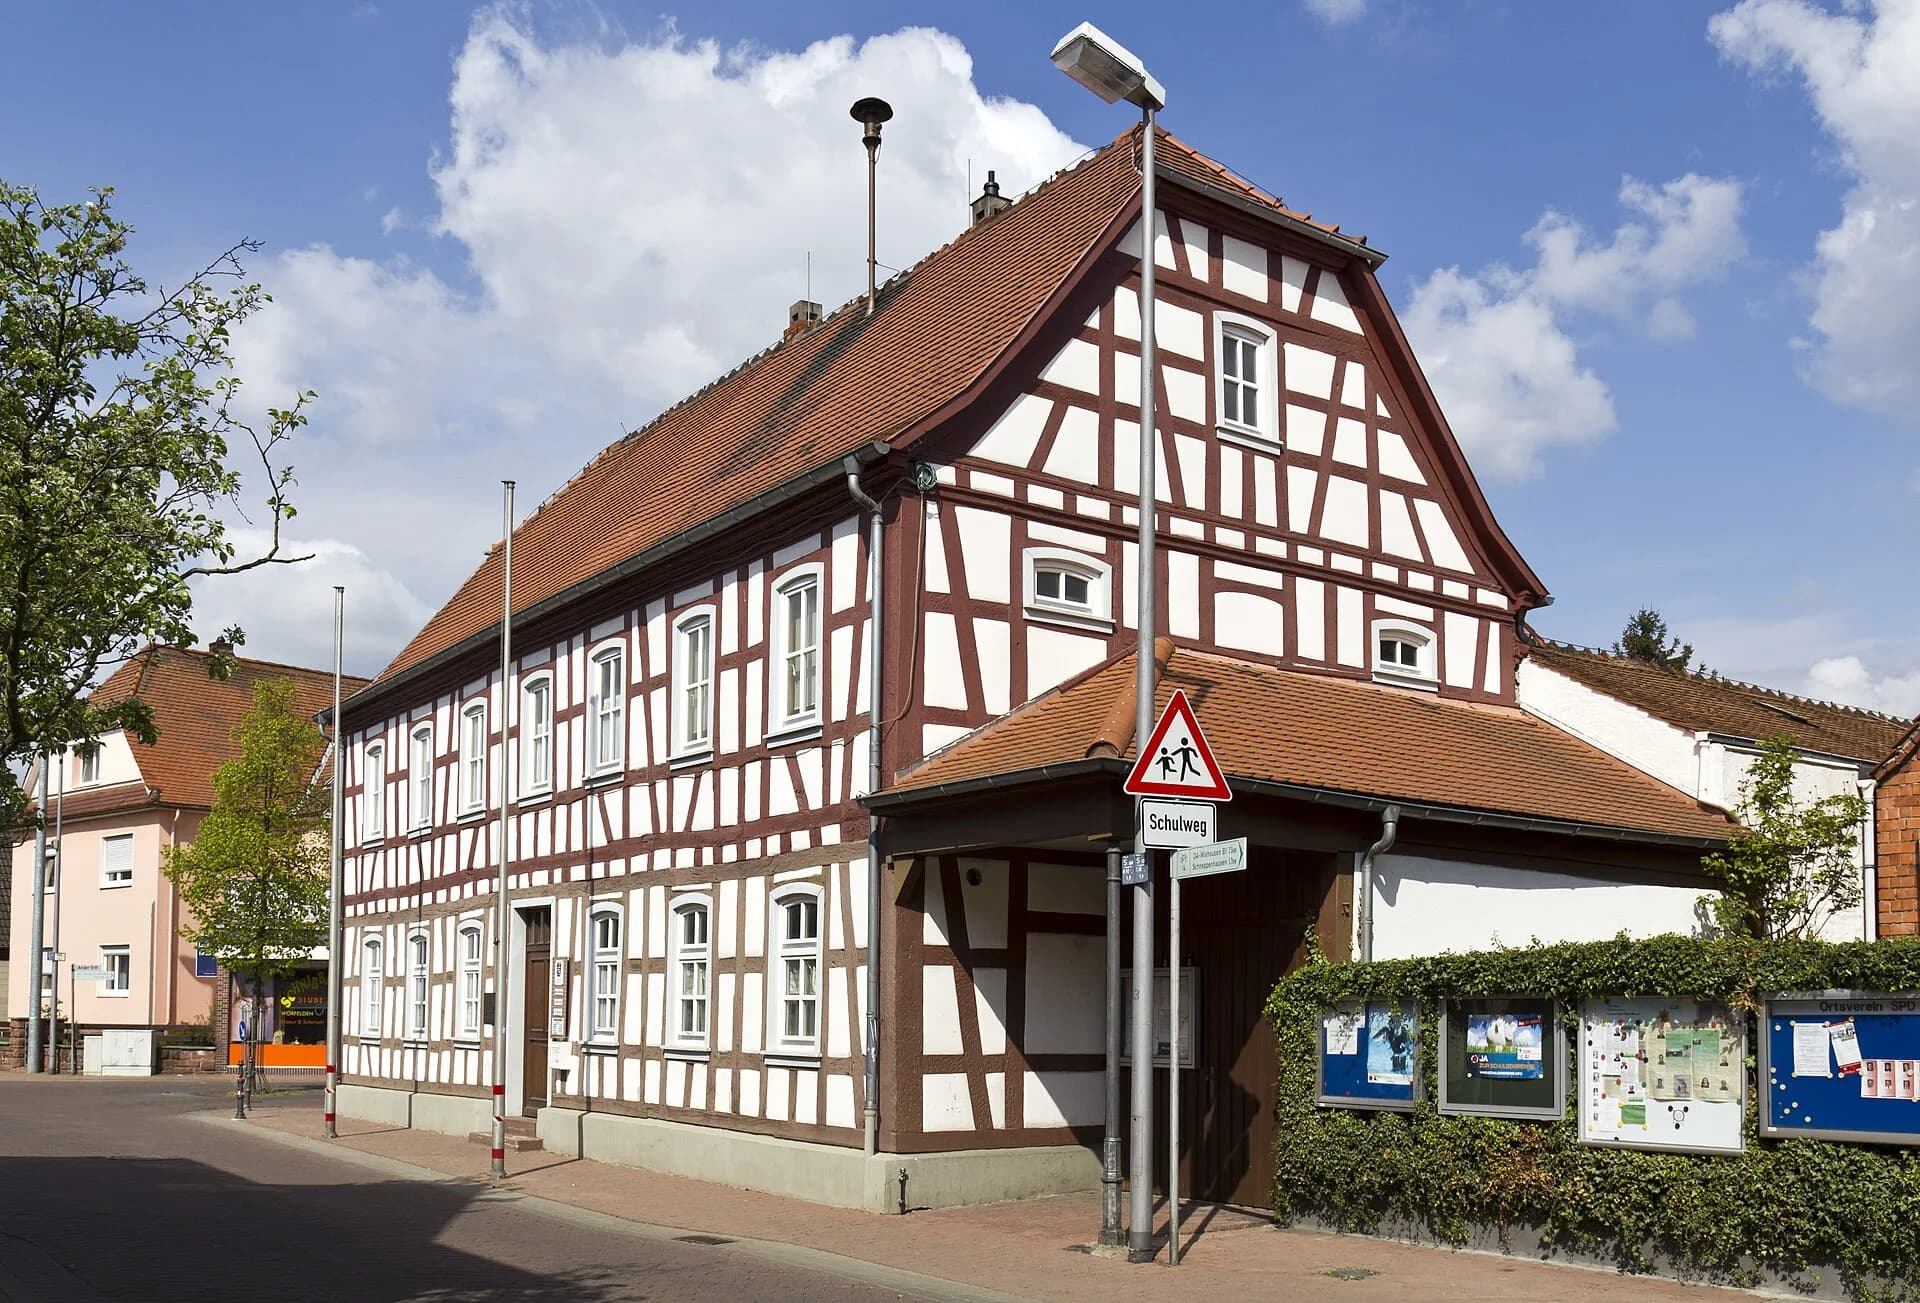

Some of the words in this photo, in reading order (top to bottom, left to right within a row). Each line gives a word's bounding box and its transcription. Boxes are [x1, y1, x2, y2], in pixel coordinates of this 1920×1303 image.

[1149, 813, 1207, 837] Schulweg
[1819, 1001, 1883, 1012] Ortsverein
[1891, 1001, 1916, 1011] SPD
[1479, 1054, 1489, 1063] JA
